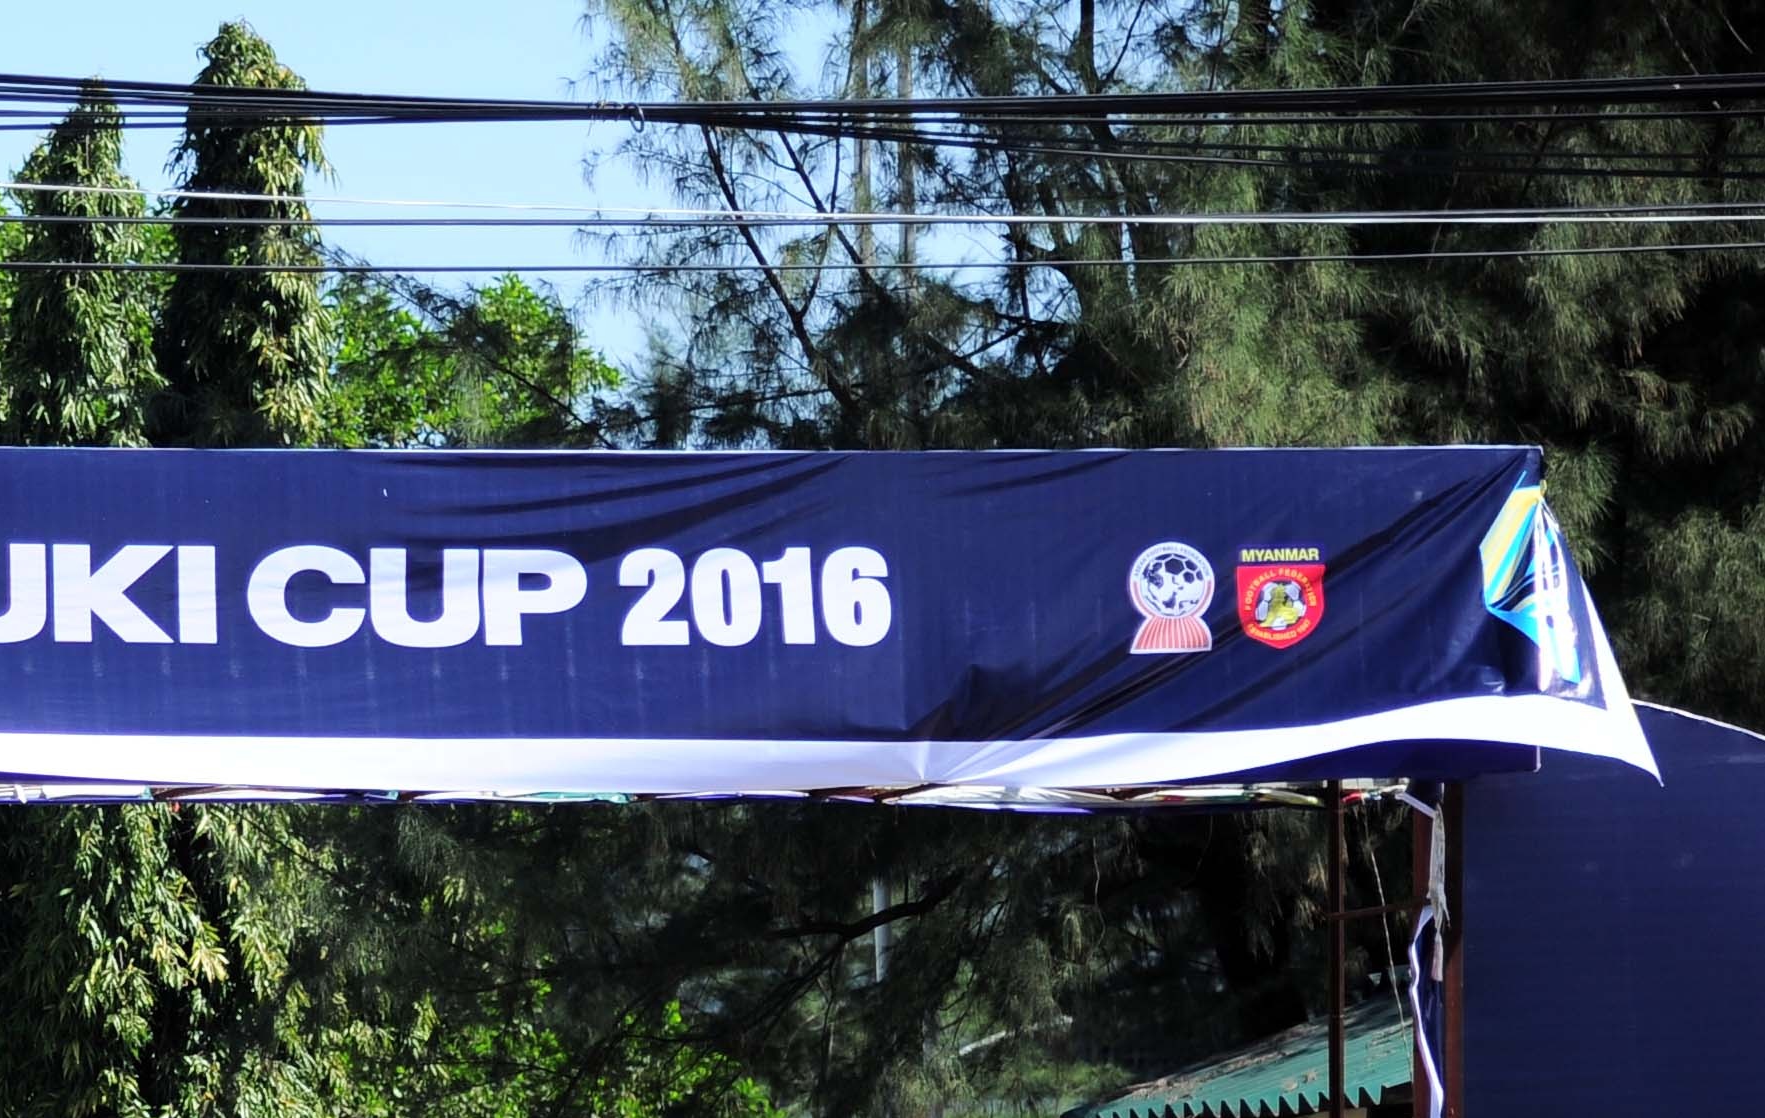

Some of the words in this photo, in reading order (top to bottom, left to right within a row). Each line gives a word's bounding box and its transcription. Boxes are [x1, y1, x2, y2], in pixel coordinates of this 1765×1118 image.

[1241, 547, 1320, 562] MYANMAR
[246, 545, 588, 648] CUP
[618, 546, 892, 647] 2016
